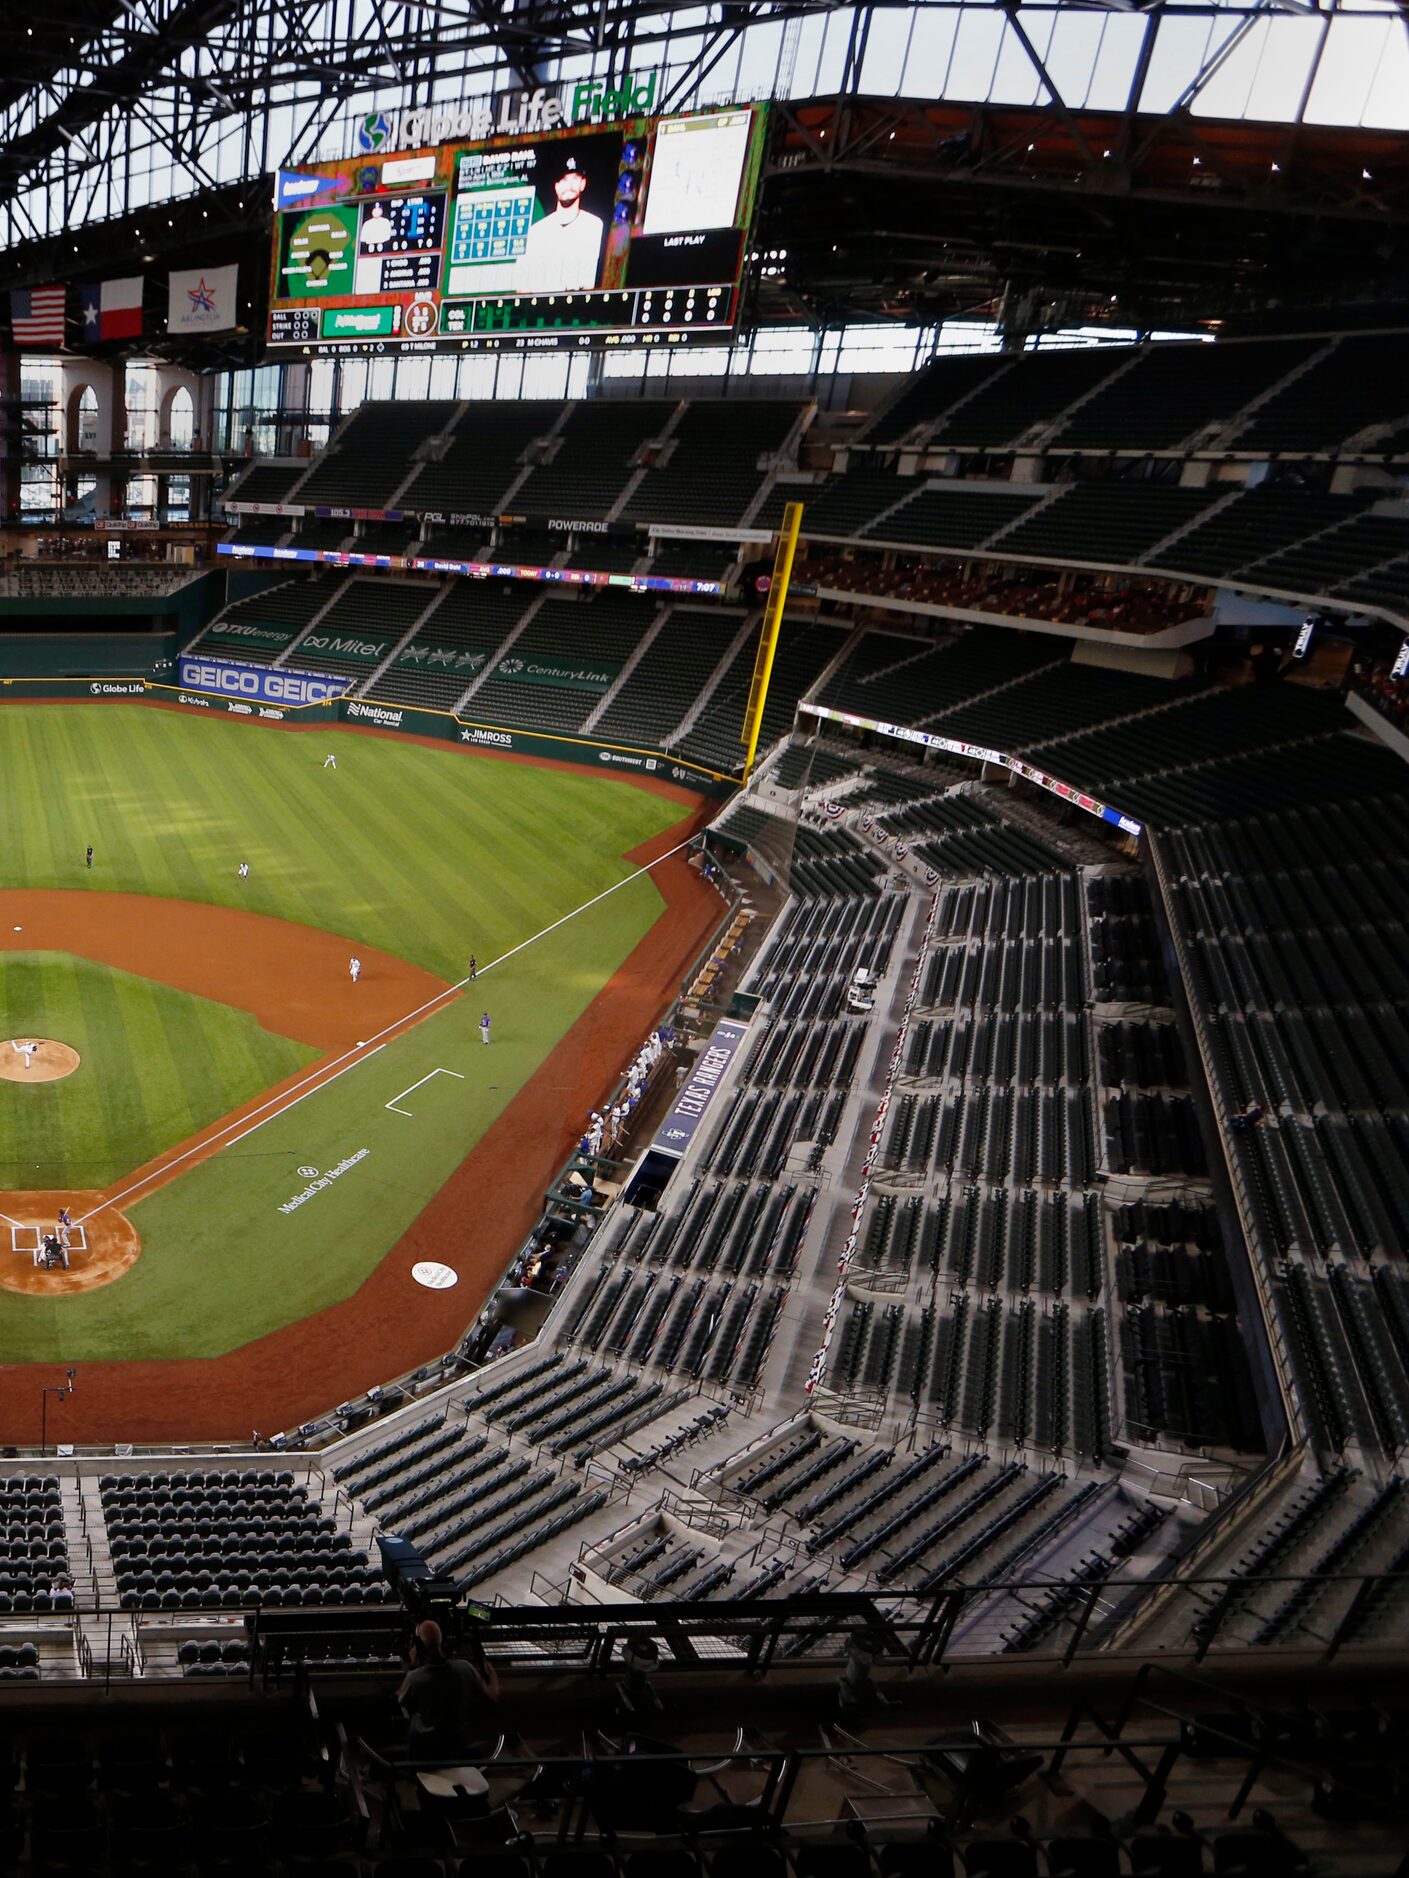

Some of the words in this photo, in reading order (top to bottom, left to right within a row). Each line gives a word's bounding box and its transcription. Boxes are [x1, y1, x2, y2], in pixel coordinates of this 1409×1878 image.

[400, 107, 492, 144] Globe
[497, 88, 562, 129] Life
[572, 72, 656, 119] Field
[664, 237, 683, 247] LAST
[684, 235, 705, 245] PLAY
[272, 322, 291, 330] STRIKE
[424, 511, 445, 523] PGL
[548, 518, 608, 532] POWERADE
[434, 561, 449, 569] David
[497, 566, 511, 574] .000
[697, 581, 715, 591] 7:07
[329, 637, 387, 657] Mitel
[183, 663, 259, 692] GEICO
[526, 663, 609, 682] CenturyLink
[102, 684, 127, 692] Globe
[128, 684, 144, 692] Life
[360, 704, 403, 721] National
[674, 1082, 709, 1118] TEXAS
[692, 1045, 732, 1086] RANGERS
[327, 1147, 370, 1179] Healthcare
